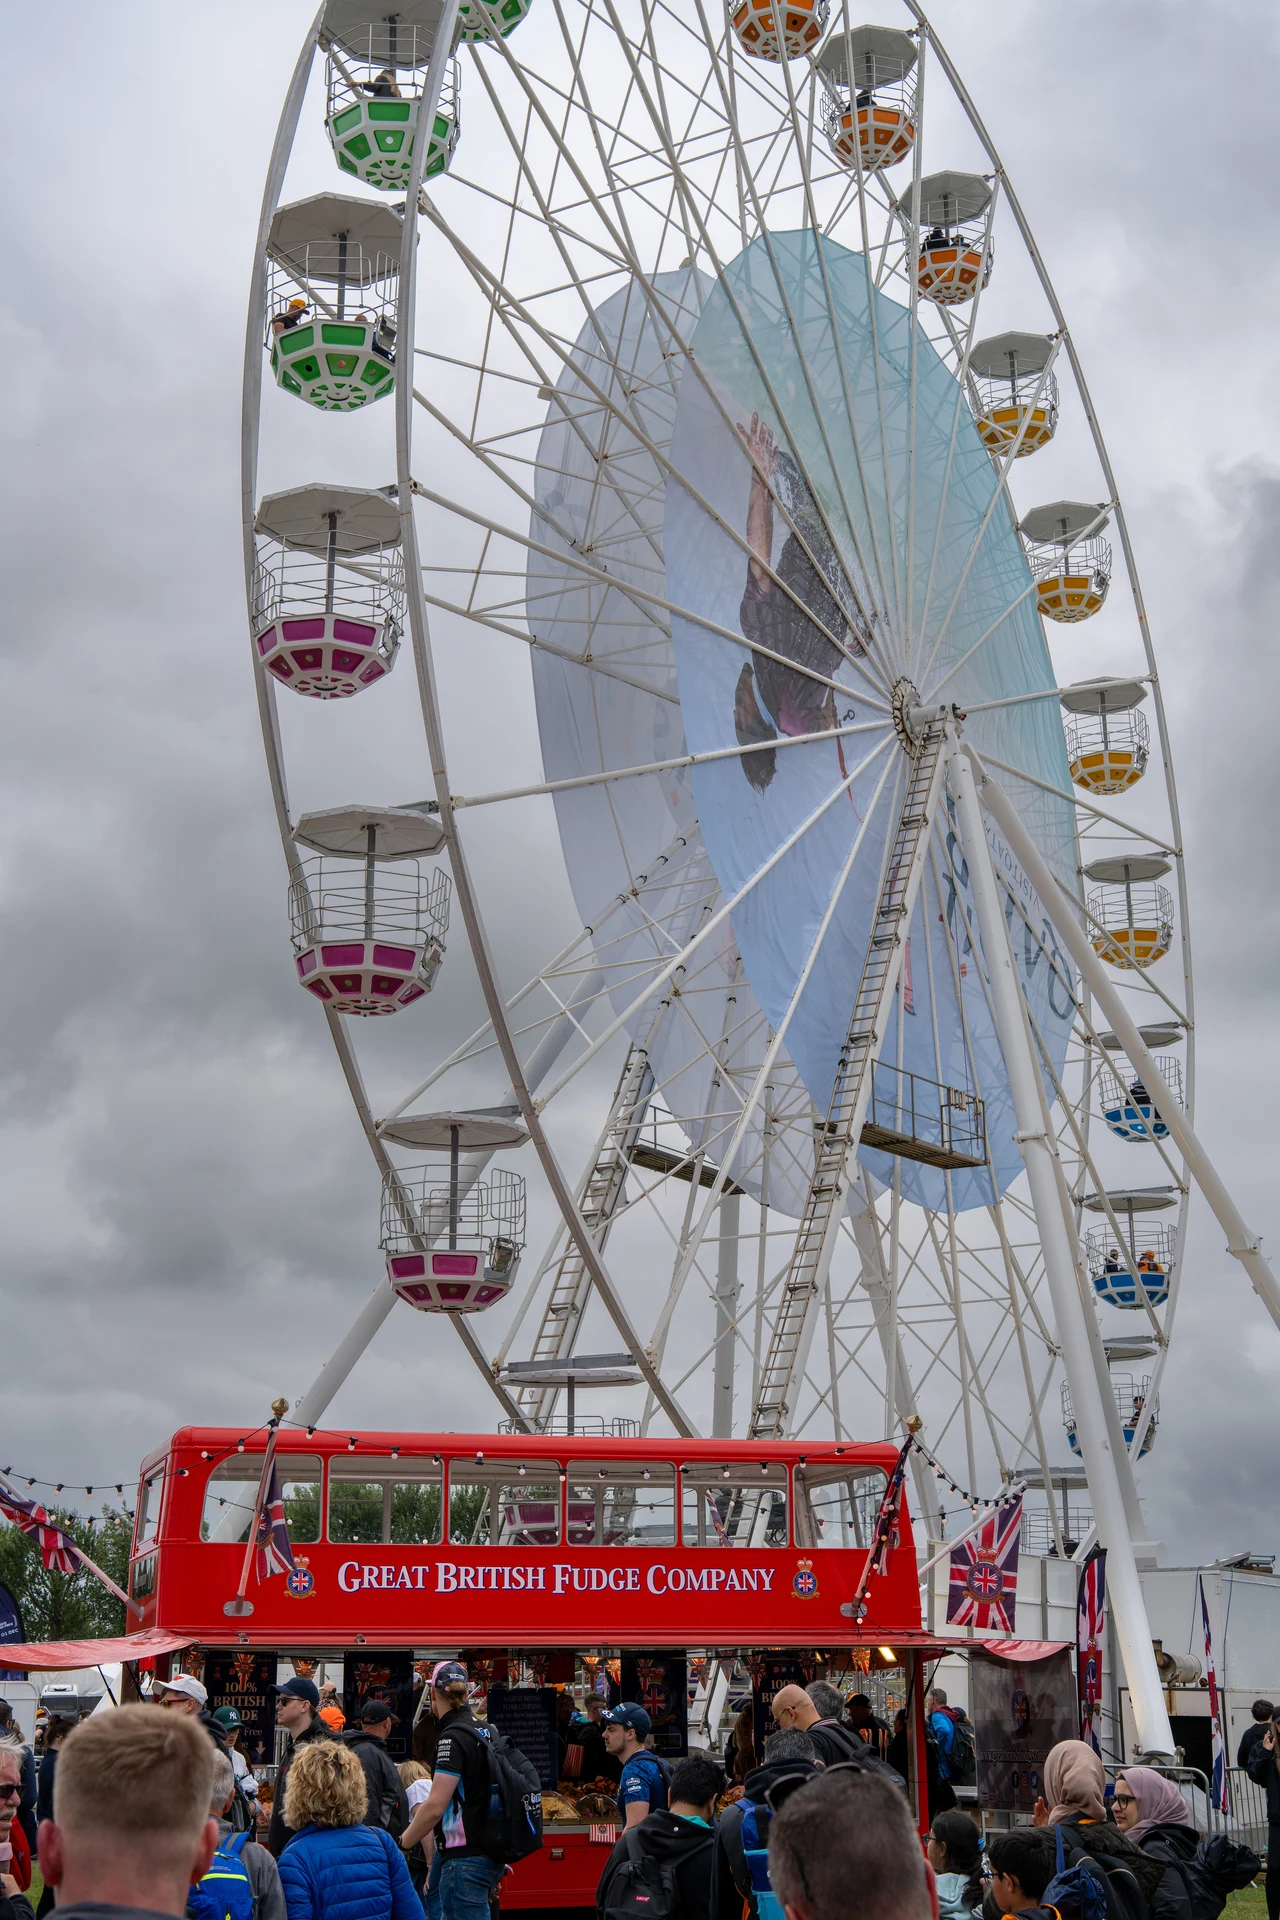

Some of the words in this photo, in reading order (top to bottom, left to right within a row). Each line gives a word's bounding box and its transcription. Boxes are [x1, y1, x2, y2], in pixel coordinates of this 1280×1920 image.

[337, 1561, 430, 1593] GREAT
[434, 1562, 546, 1593] BRITISH
[552, 1564, 641, 1594] FUDGE
[646, 1564, 776, 1595] COMPANY
[225, 1681, 258, 1692] 100%
[213, 1695, 266, 1707] BRITISH
[241, 1709, 258, 1721] DE
[244, 1727, 263, 1736] Free
